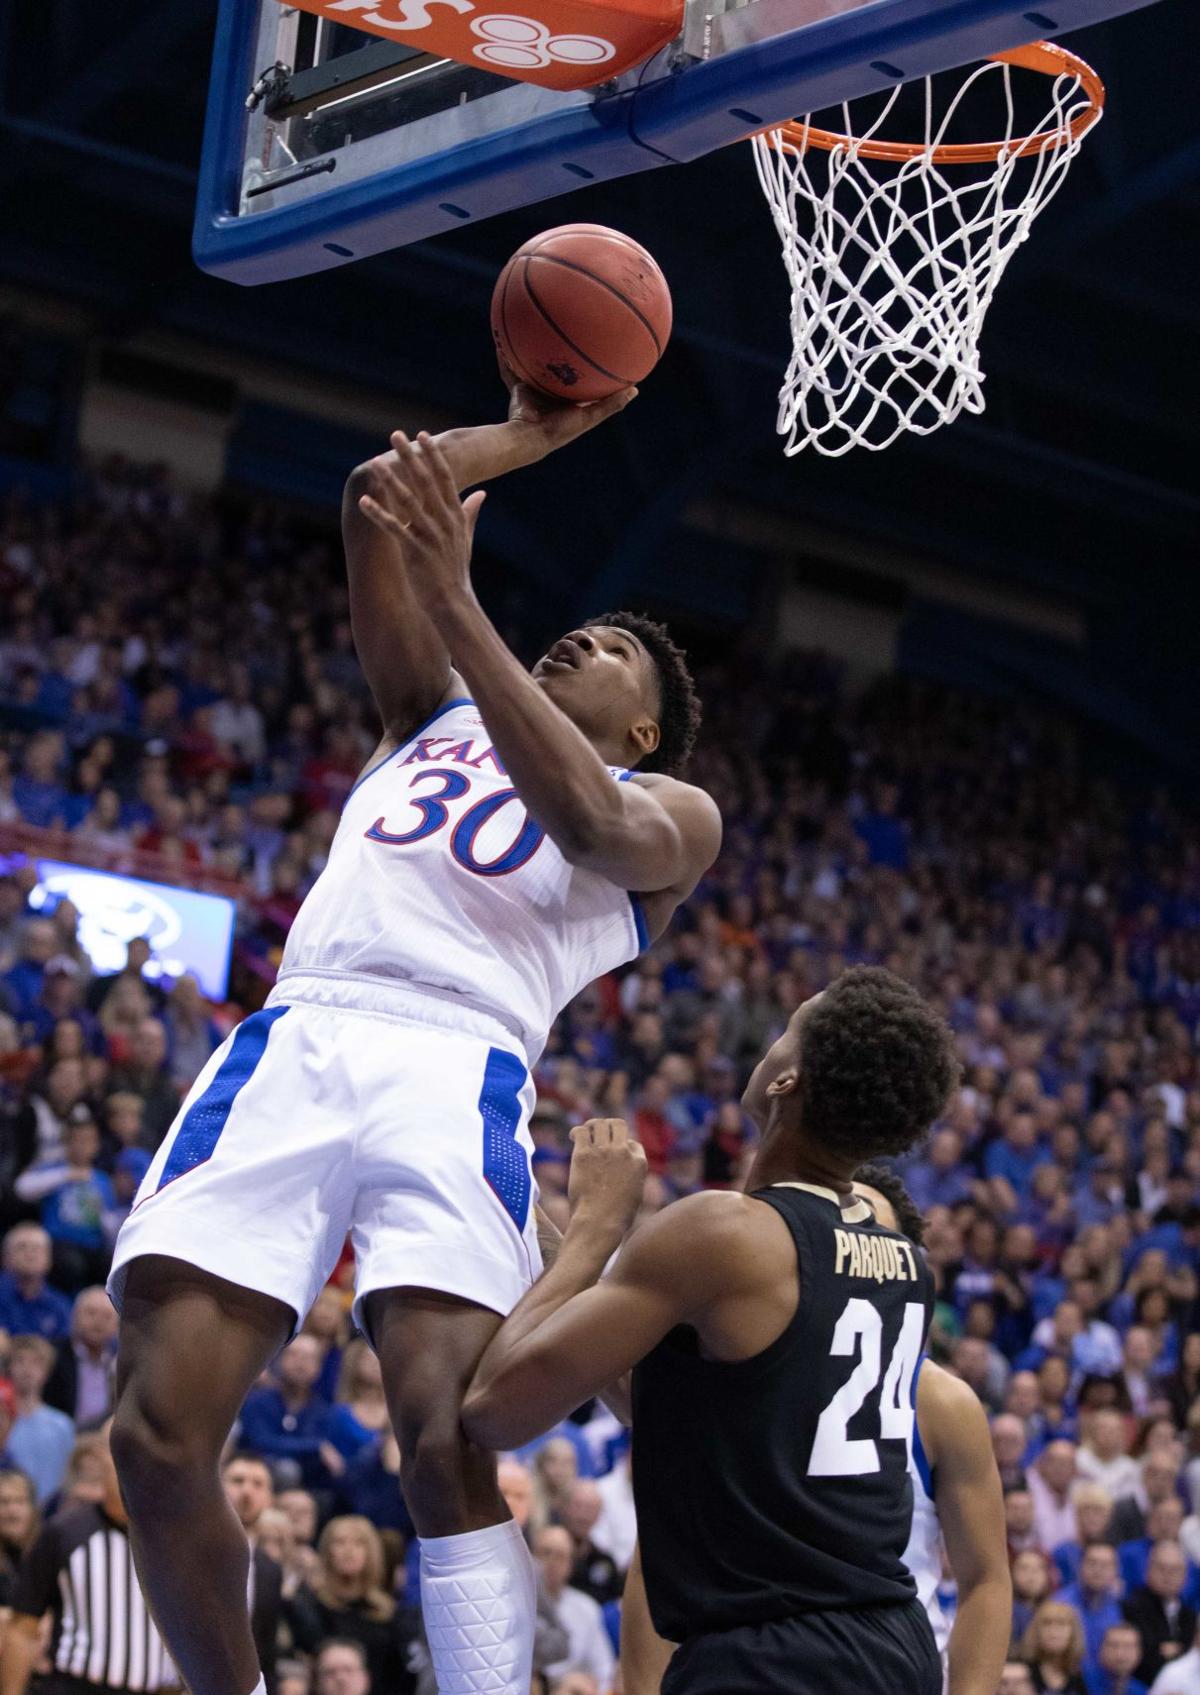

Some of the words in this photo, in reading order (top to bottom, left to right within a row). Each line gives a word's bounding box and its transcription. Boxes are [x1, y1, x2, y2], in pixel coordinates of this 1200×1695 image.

[364, 769, 547, 878] 30
[833, 1228, 919, 1284] PARQUET
[806, 1298, 925, 1477] 24
